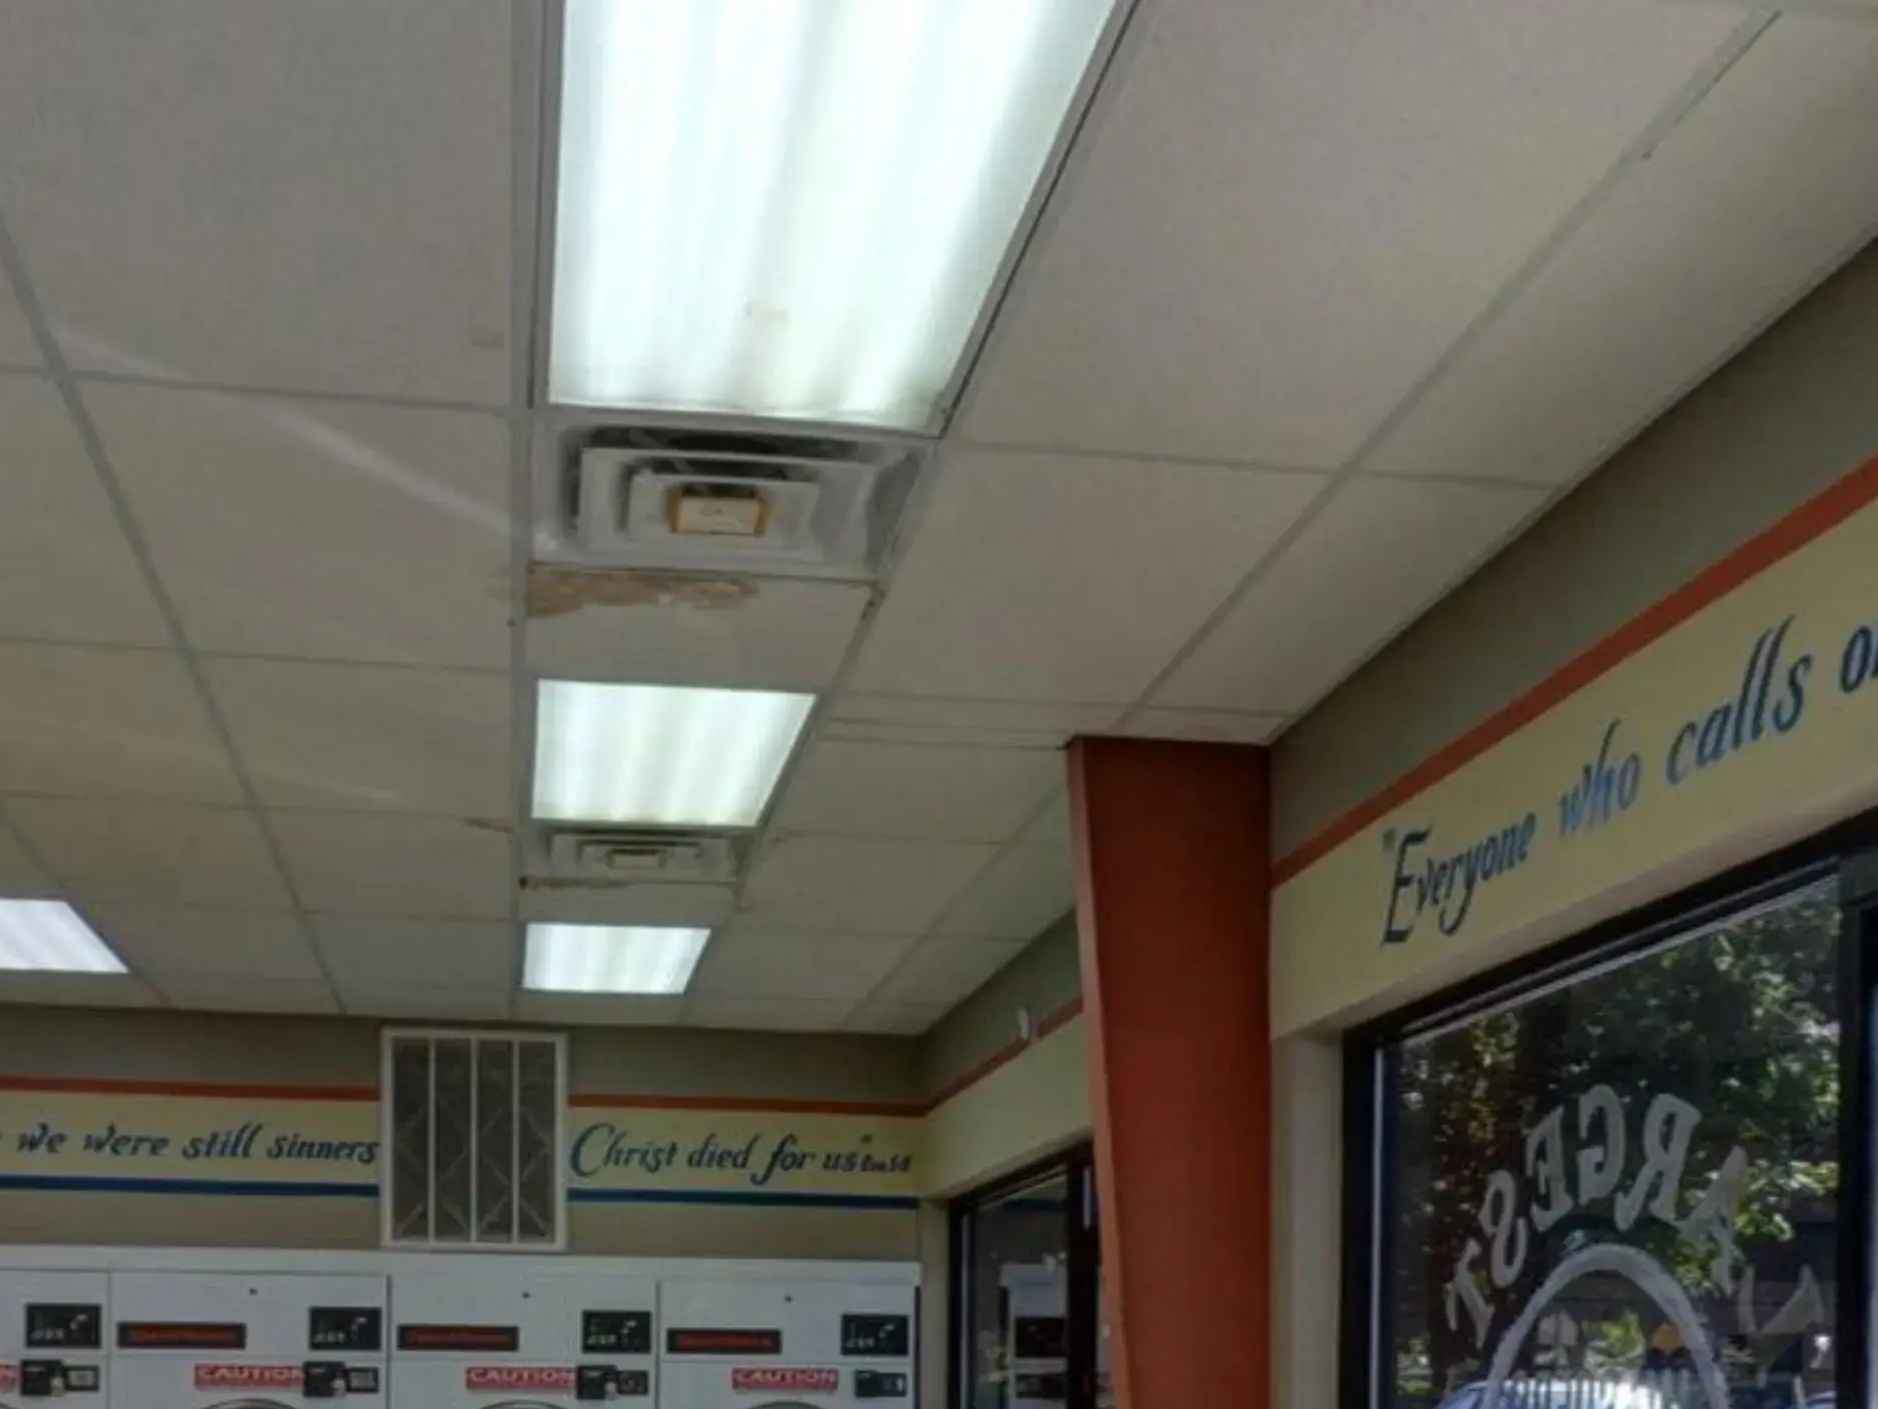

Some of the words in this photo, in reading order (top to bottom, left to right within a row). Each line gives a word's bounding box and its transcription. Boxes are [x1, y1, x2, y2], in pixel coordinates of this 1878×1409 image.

[1379, 810, 1537, 947] "Everyone
[1558, 719, 1640, 839] who
[1664, 616, 1813, 786] calls
[17, 1120, 70, 1155] we
[82, 1119, 172, 1159] were
[181, 1119, 265, 1161] still
[266, 1131, 381, 1166] sinners
[571, 1120, 678, 1178] Christ
[685, 1132, 762, 1170] died
[749, 1132, 818, 1186] for
[734, 1369, 837, 1387] CAUTION
